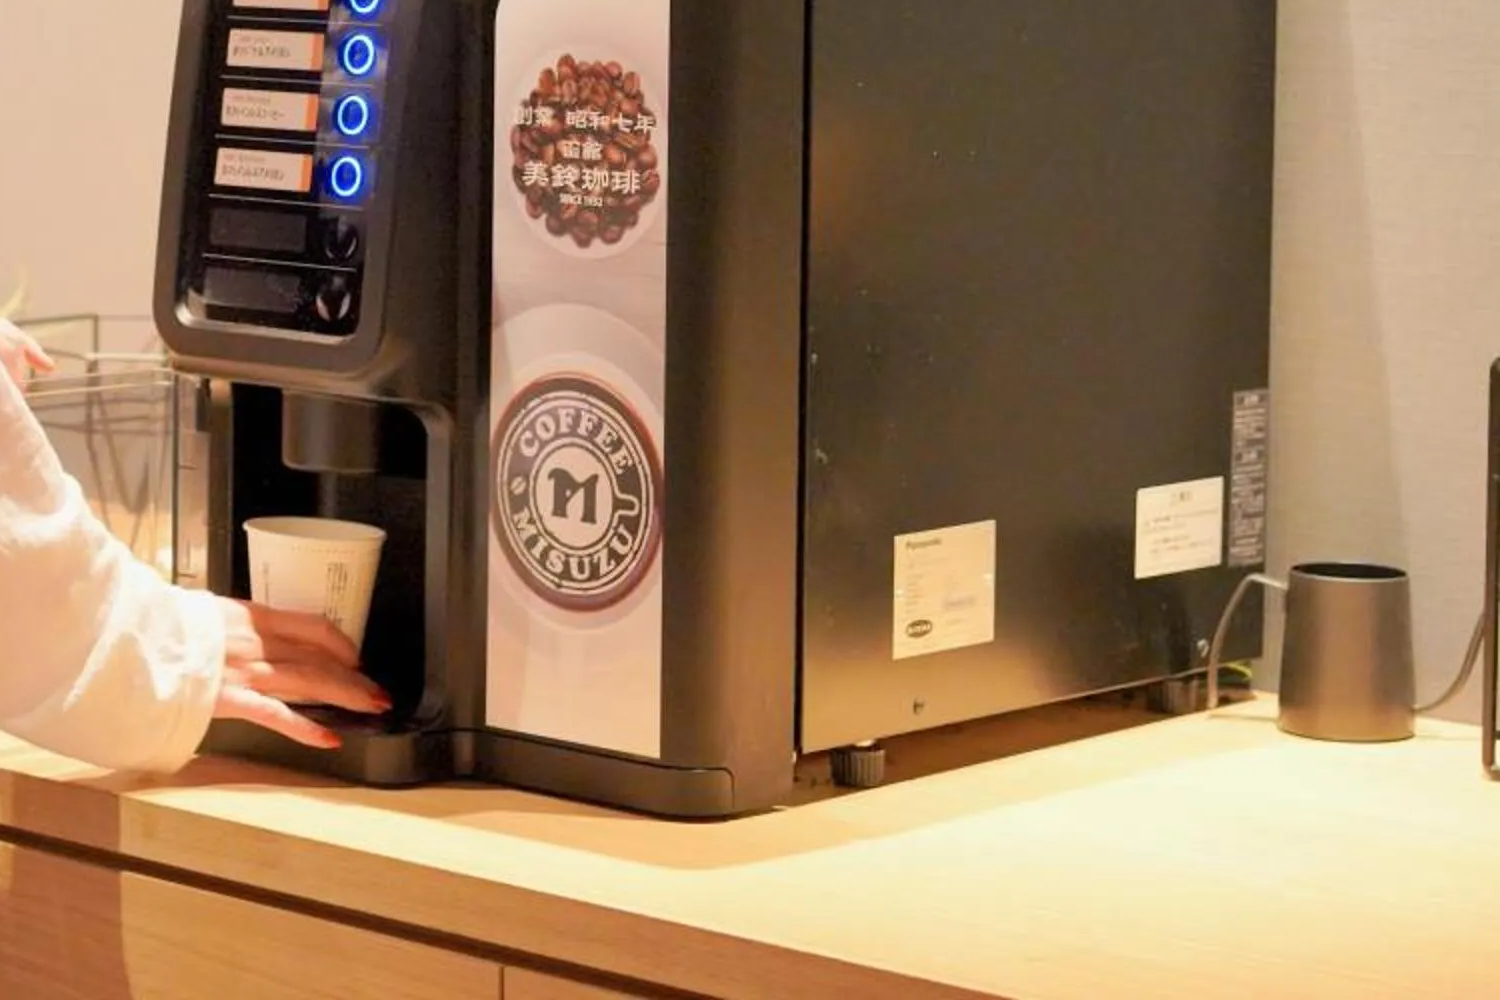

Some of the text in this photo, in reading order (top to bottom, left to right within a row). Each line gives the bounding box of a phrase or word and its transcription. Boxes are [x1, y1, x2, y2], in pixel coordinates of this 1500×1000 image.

[565, 110, 657, 134] 昭和七年
[522, 161, 641, 195] 美鈴珈琲
[519, 408, 634, 475] COFFEE
[513, 506, 634, 580] MISUZU
